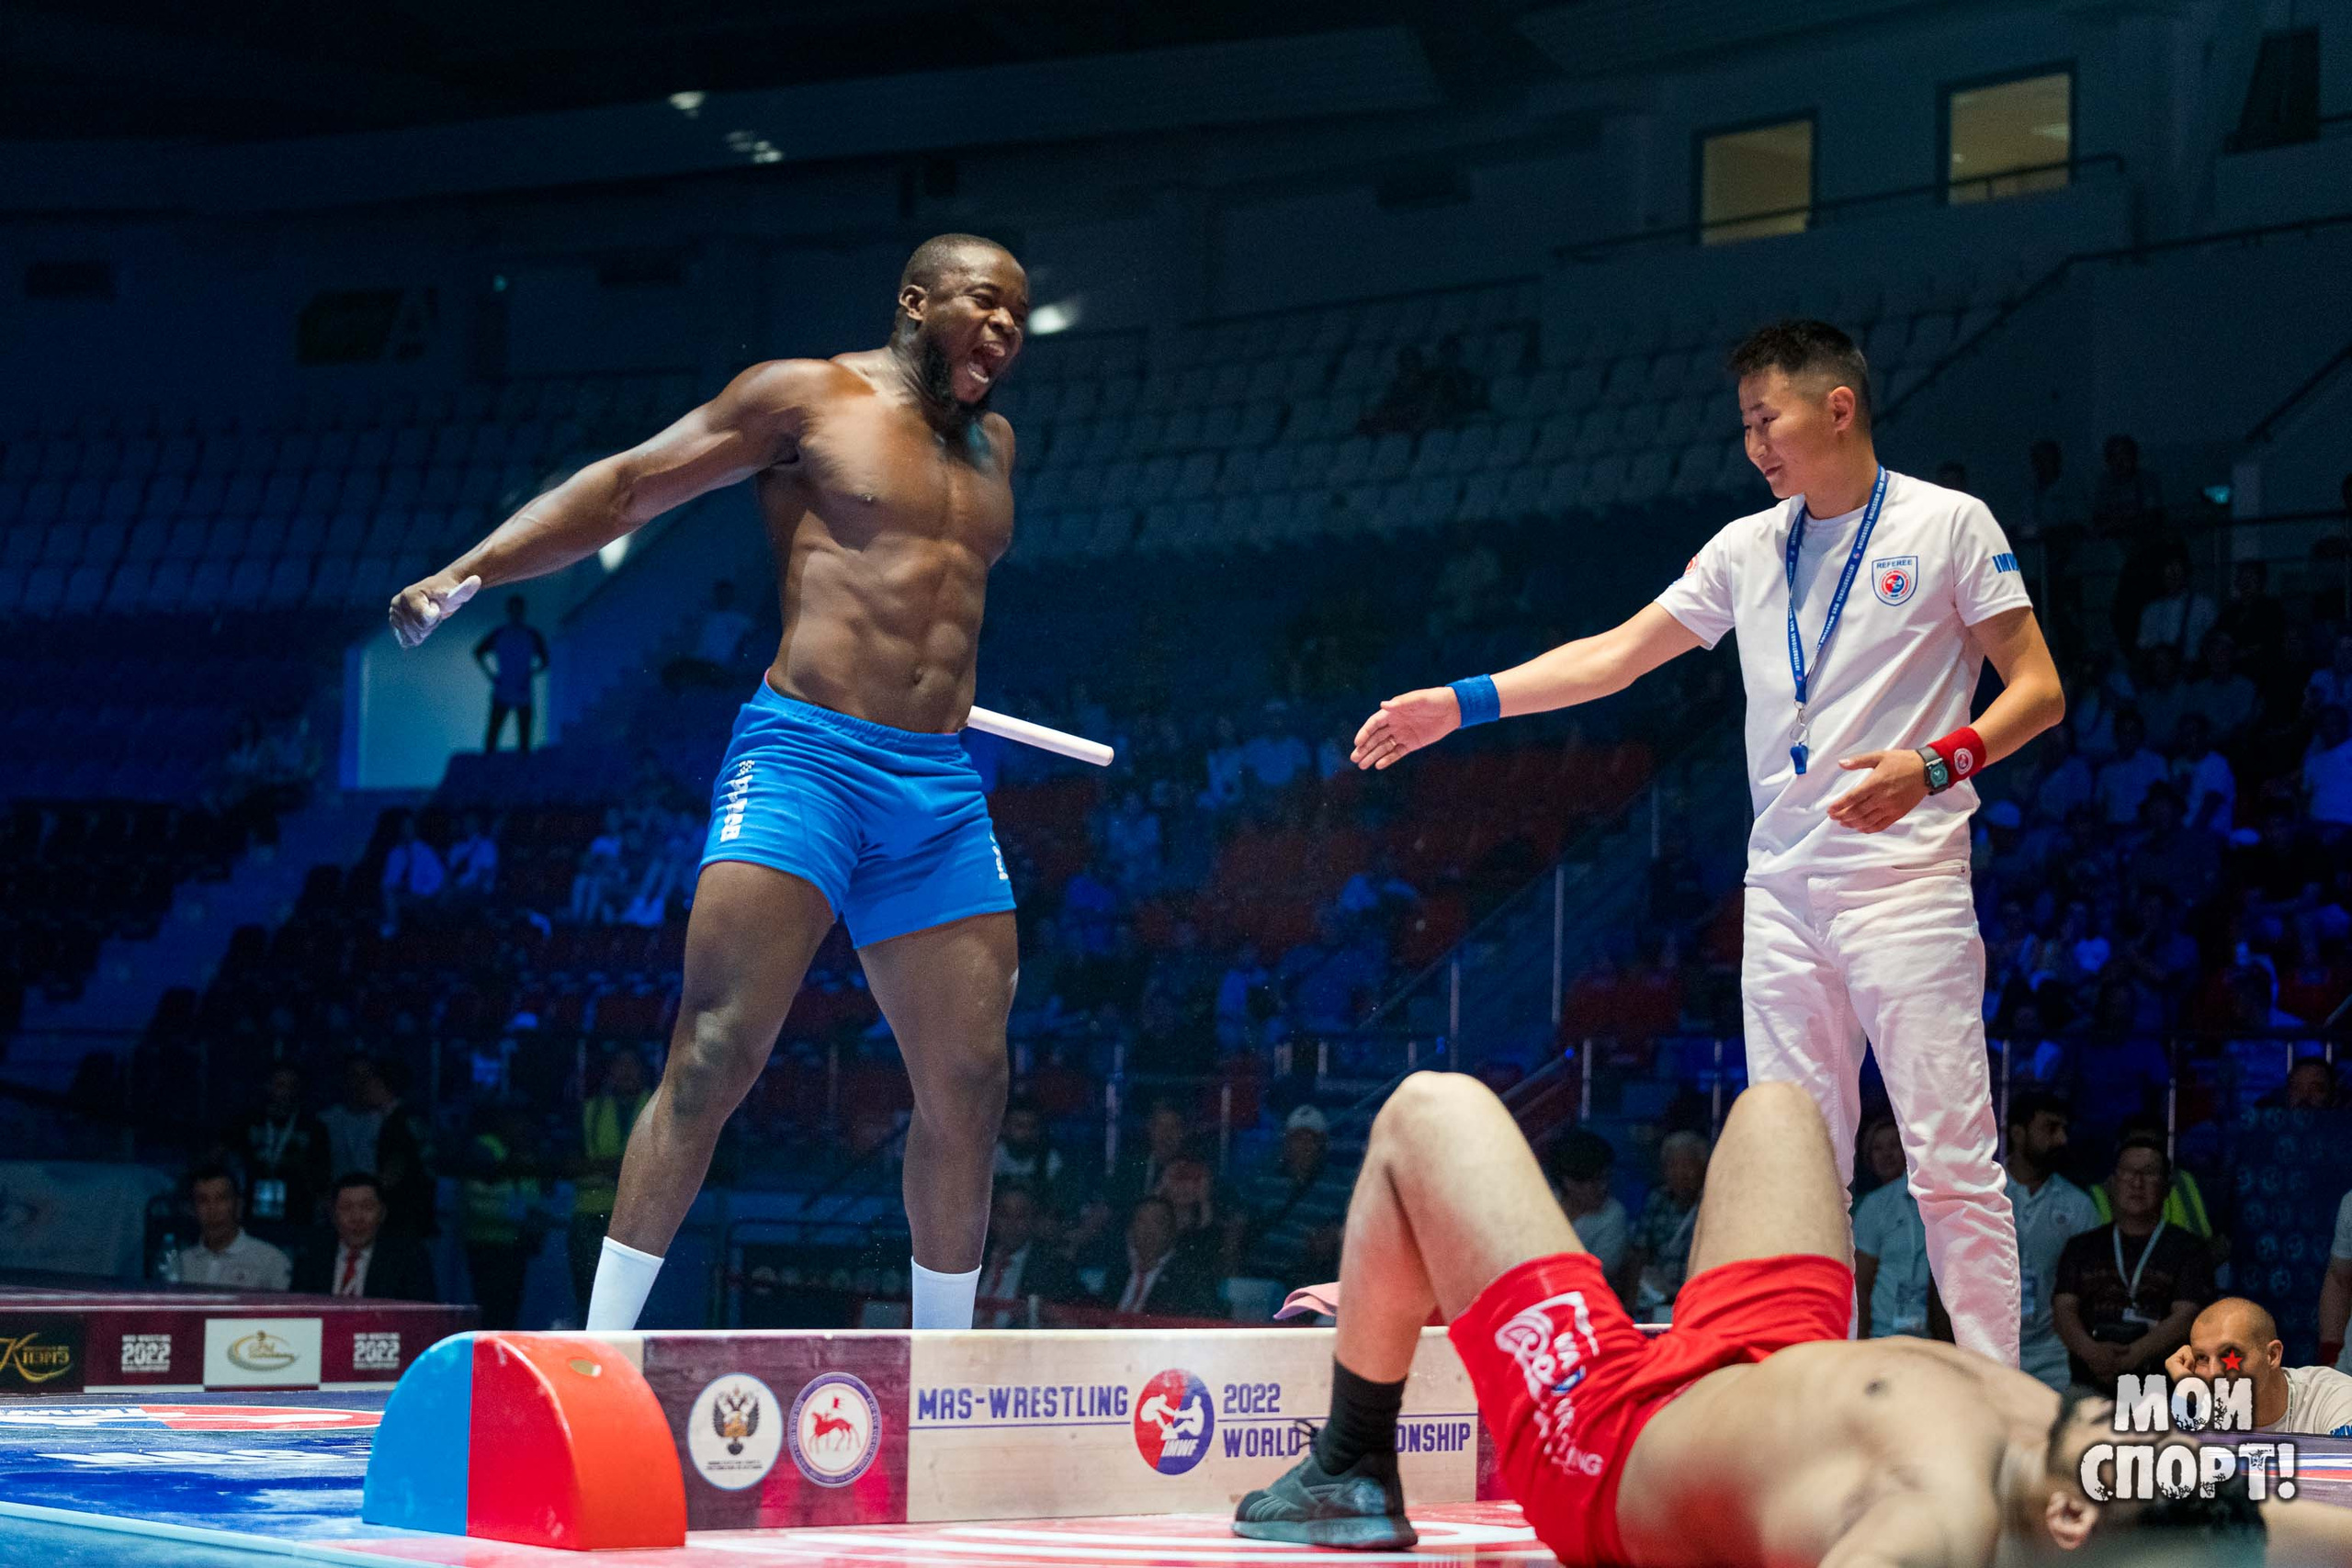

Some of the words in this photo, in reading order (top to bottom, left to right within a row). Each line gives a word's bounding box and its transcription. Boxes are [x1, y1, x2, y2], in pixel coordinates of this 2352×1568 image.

[1877, 559, 1912, 569] REFEREE
[1992, 553, 2020, 573] IMW
[122, 1342, 171, 1364] 2022
[354, 1341, 400, 1361] 2022
[918, 1385, 1128, 1420] MAS-WRESTLING
[1223, 1383, 1281, 1414] 2022
[1223, 1427, 1301, 1459] WORLD
